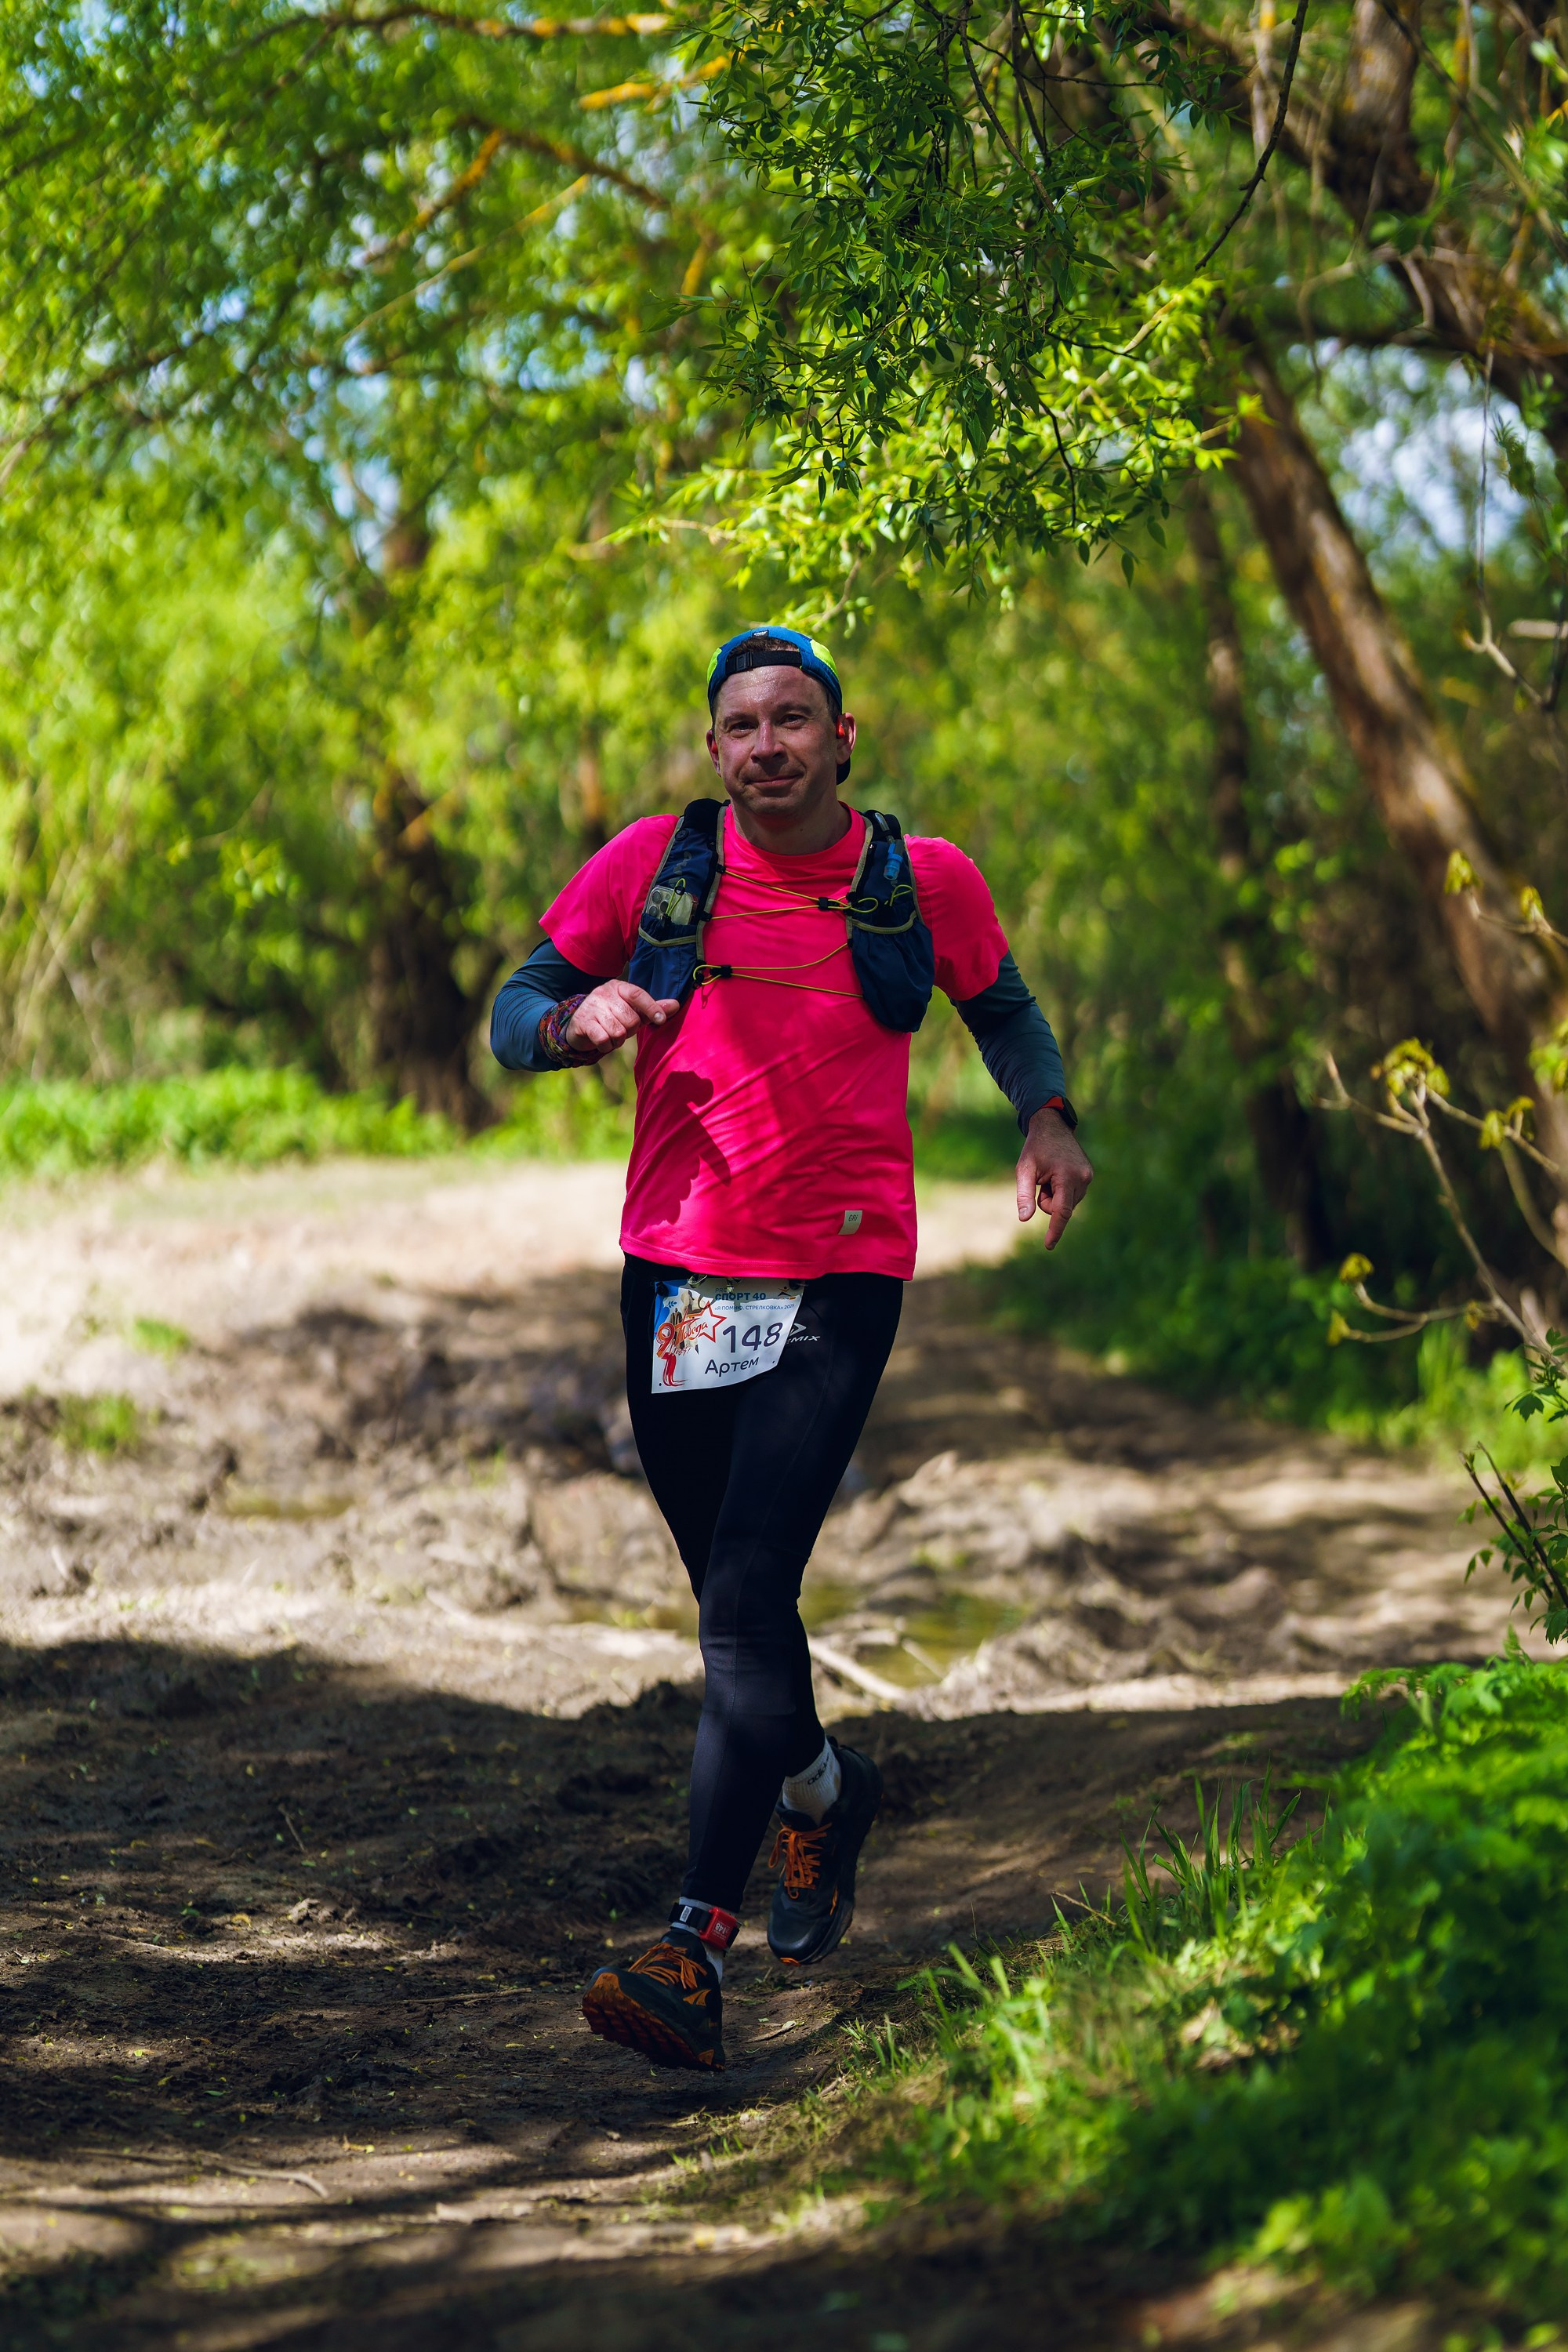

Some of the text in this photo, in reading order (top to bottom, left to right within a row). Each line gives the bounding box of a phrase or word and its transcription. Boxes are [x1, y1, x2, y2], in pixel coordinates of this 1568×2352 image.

[715, 1292, 749, 1301] СПОРТ
[752, 1292, 767, 1301] 40
[722, 1322, 783, 1353] 148
[704, 1357, 759, 1377] Артем
